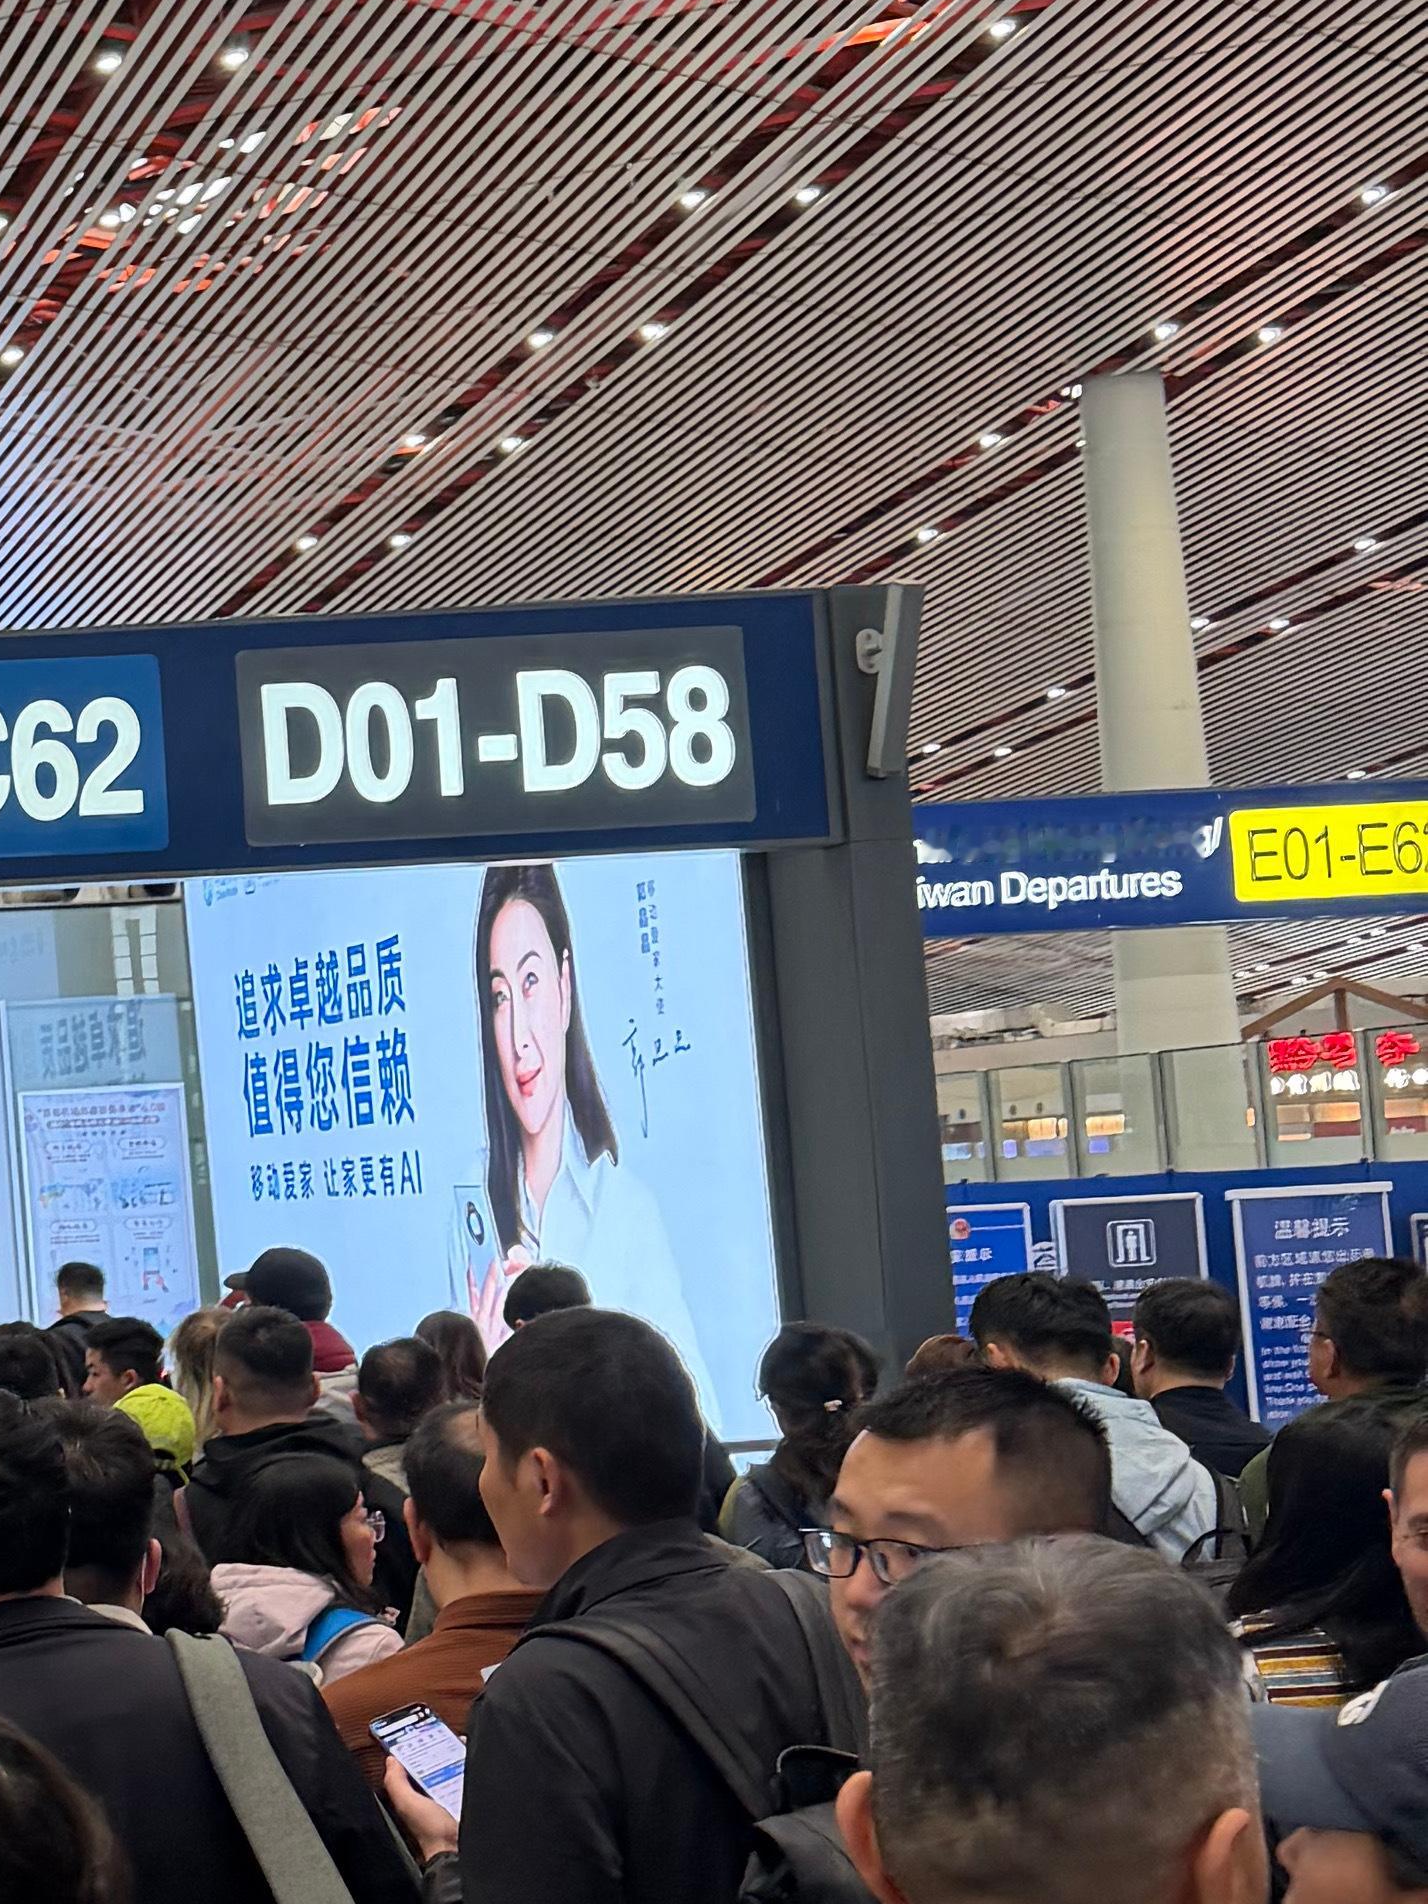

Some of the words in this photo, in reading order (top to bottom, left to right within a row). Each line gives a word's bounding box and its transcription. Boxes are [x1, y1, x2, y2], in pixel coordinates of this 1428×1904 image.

[261, 666, 735, 805] D01-D58
[1000, 868, 1183, 910] Departures
[234, 934, 406, 1040] 追求卓越品质
[242, 1027, 415, 1138] 值得您信赖
[250, 1161, 315, 1202] 移动爱家
[323, 1150, 423, 1198] 让家更有AI
[1275, 1217, 1350, 1241] 温馨提示
